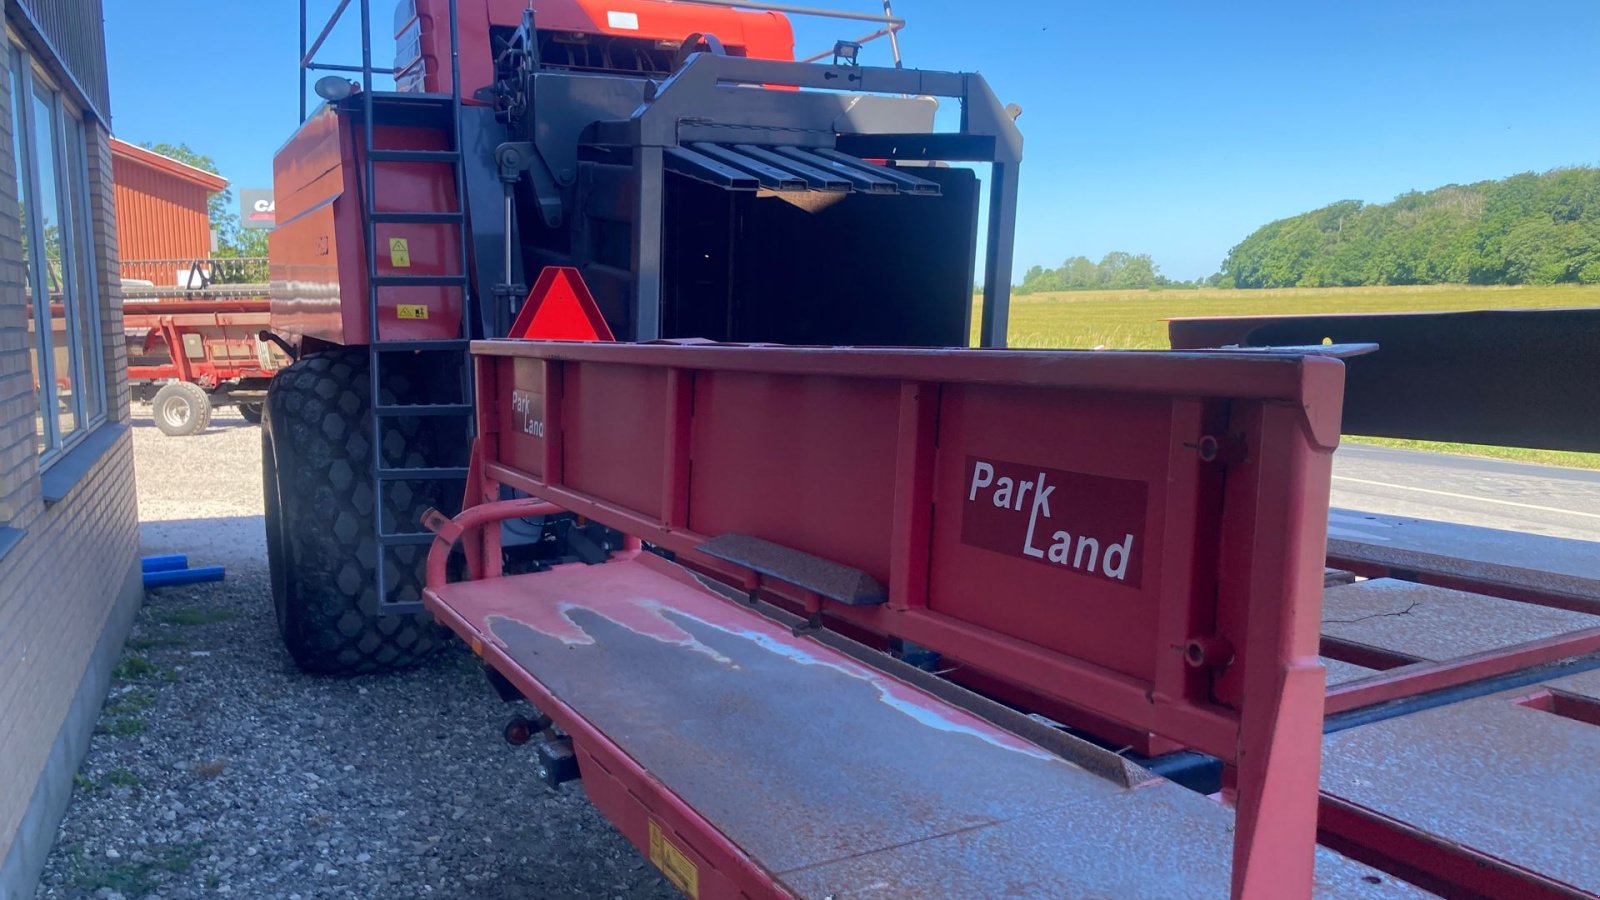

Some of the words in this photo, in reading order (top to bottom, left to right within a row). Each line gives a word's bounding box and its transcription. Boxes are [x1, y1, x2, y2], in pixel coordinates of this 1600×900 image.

[512, 391, 530, 414] Park
[969, 461, 1056, 517] Park
[1023, 512, 1134, 580] Land
